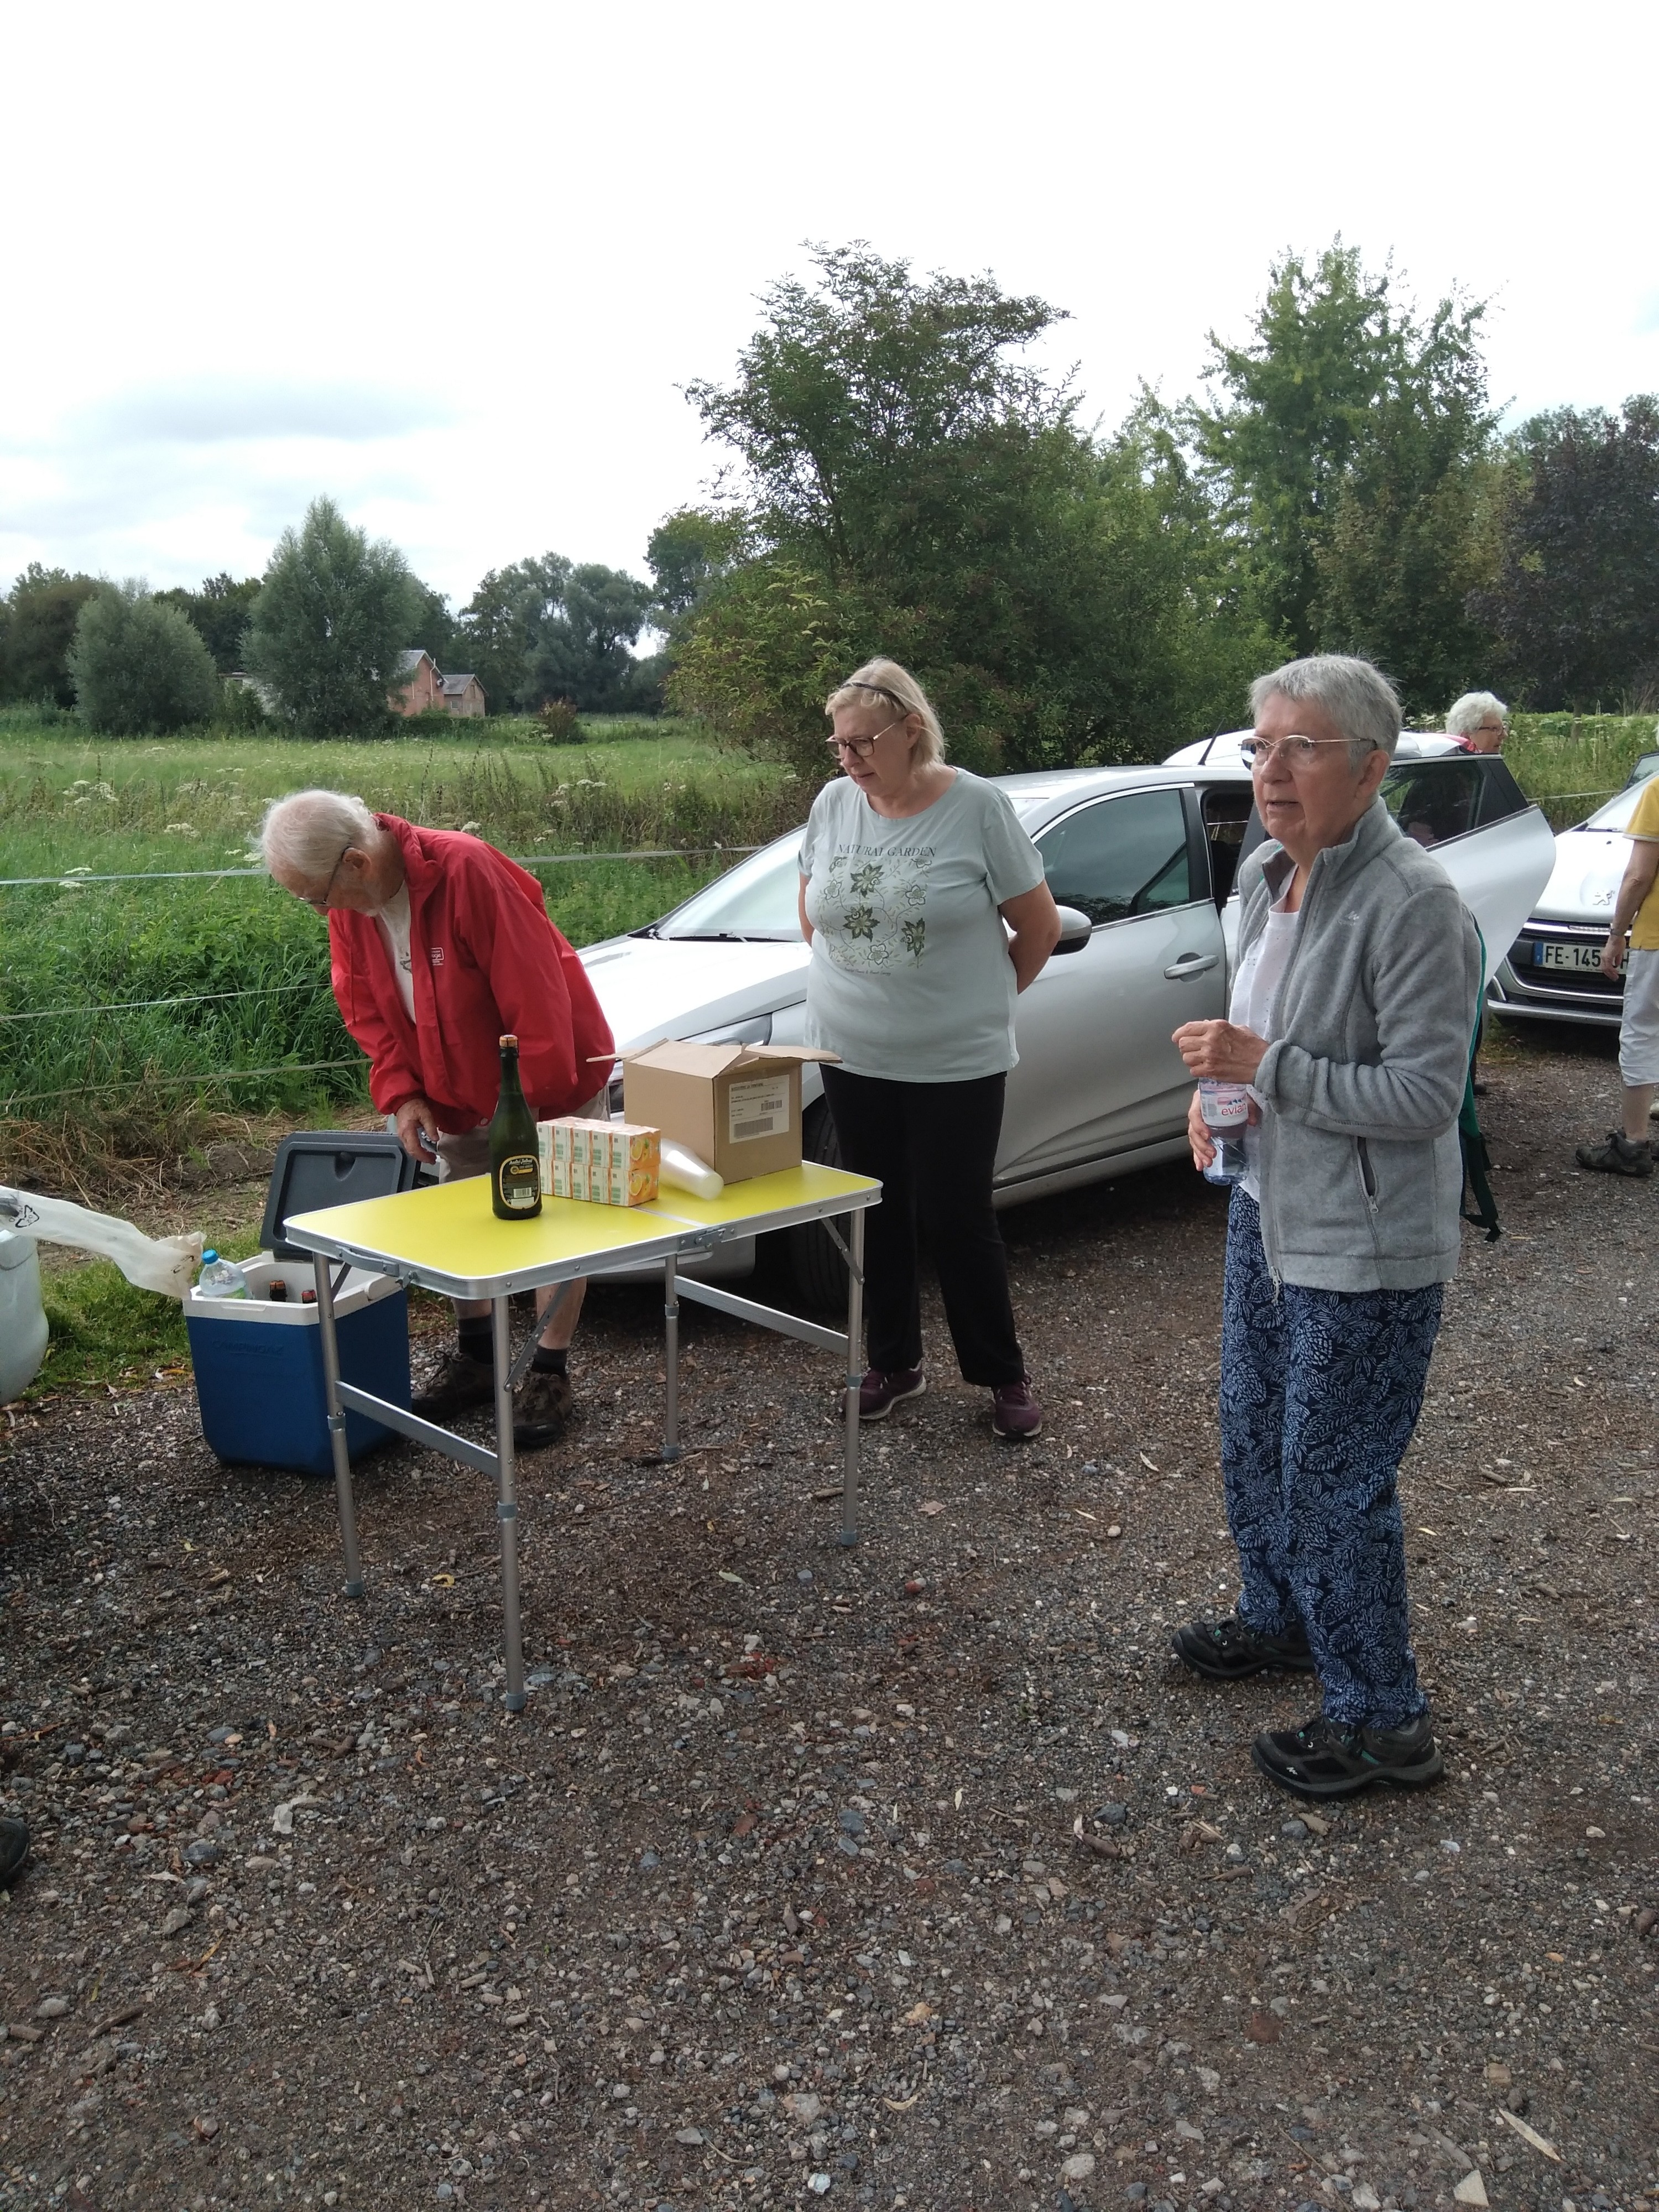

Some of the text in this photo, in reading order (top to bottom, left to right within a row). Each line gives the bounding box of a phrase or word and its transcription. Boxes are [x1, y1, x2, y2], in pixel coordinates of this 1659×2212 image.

[838, 844, 936, 857] NATURAL GARDEN
[1221, 1103, 1246, 1116] evian
